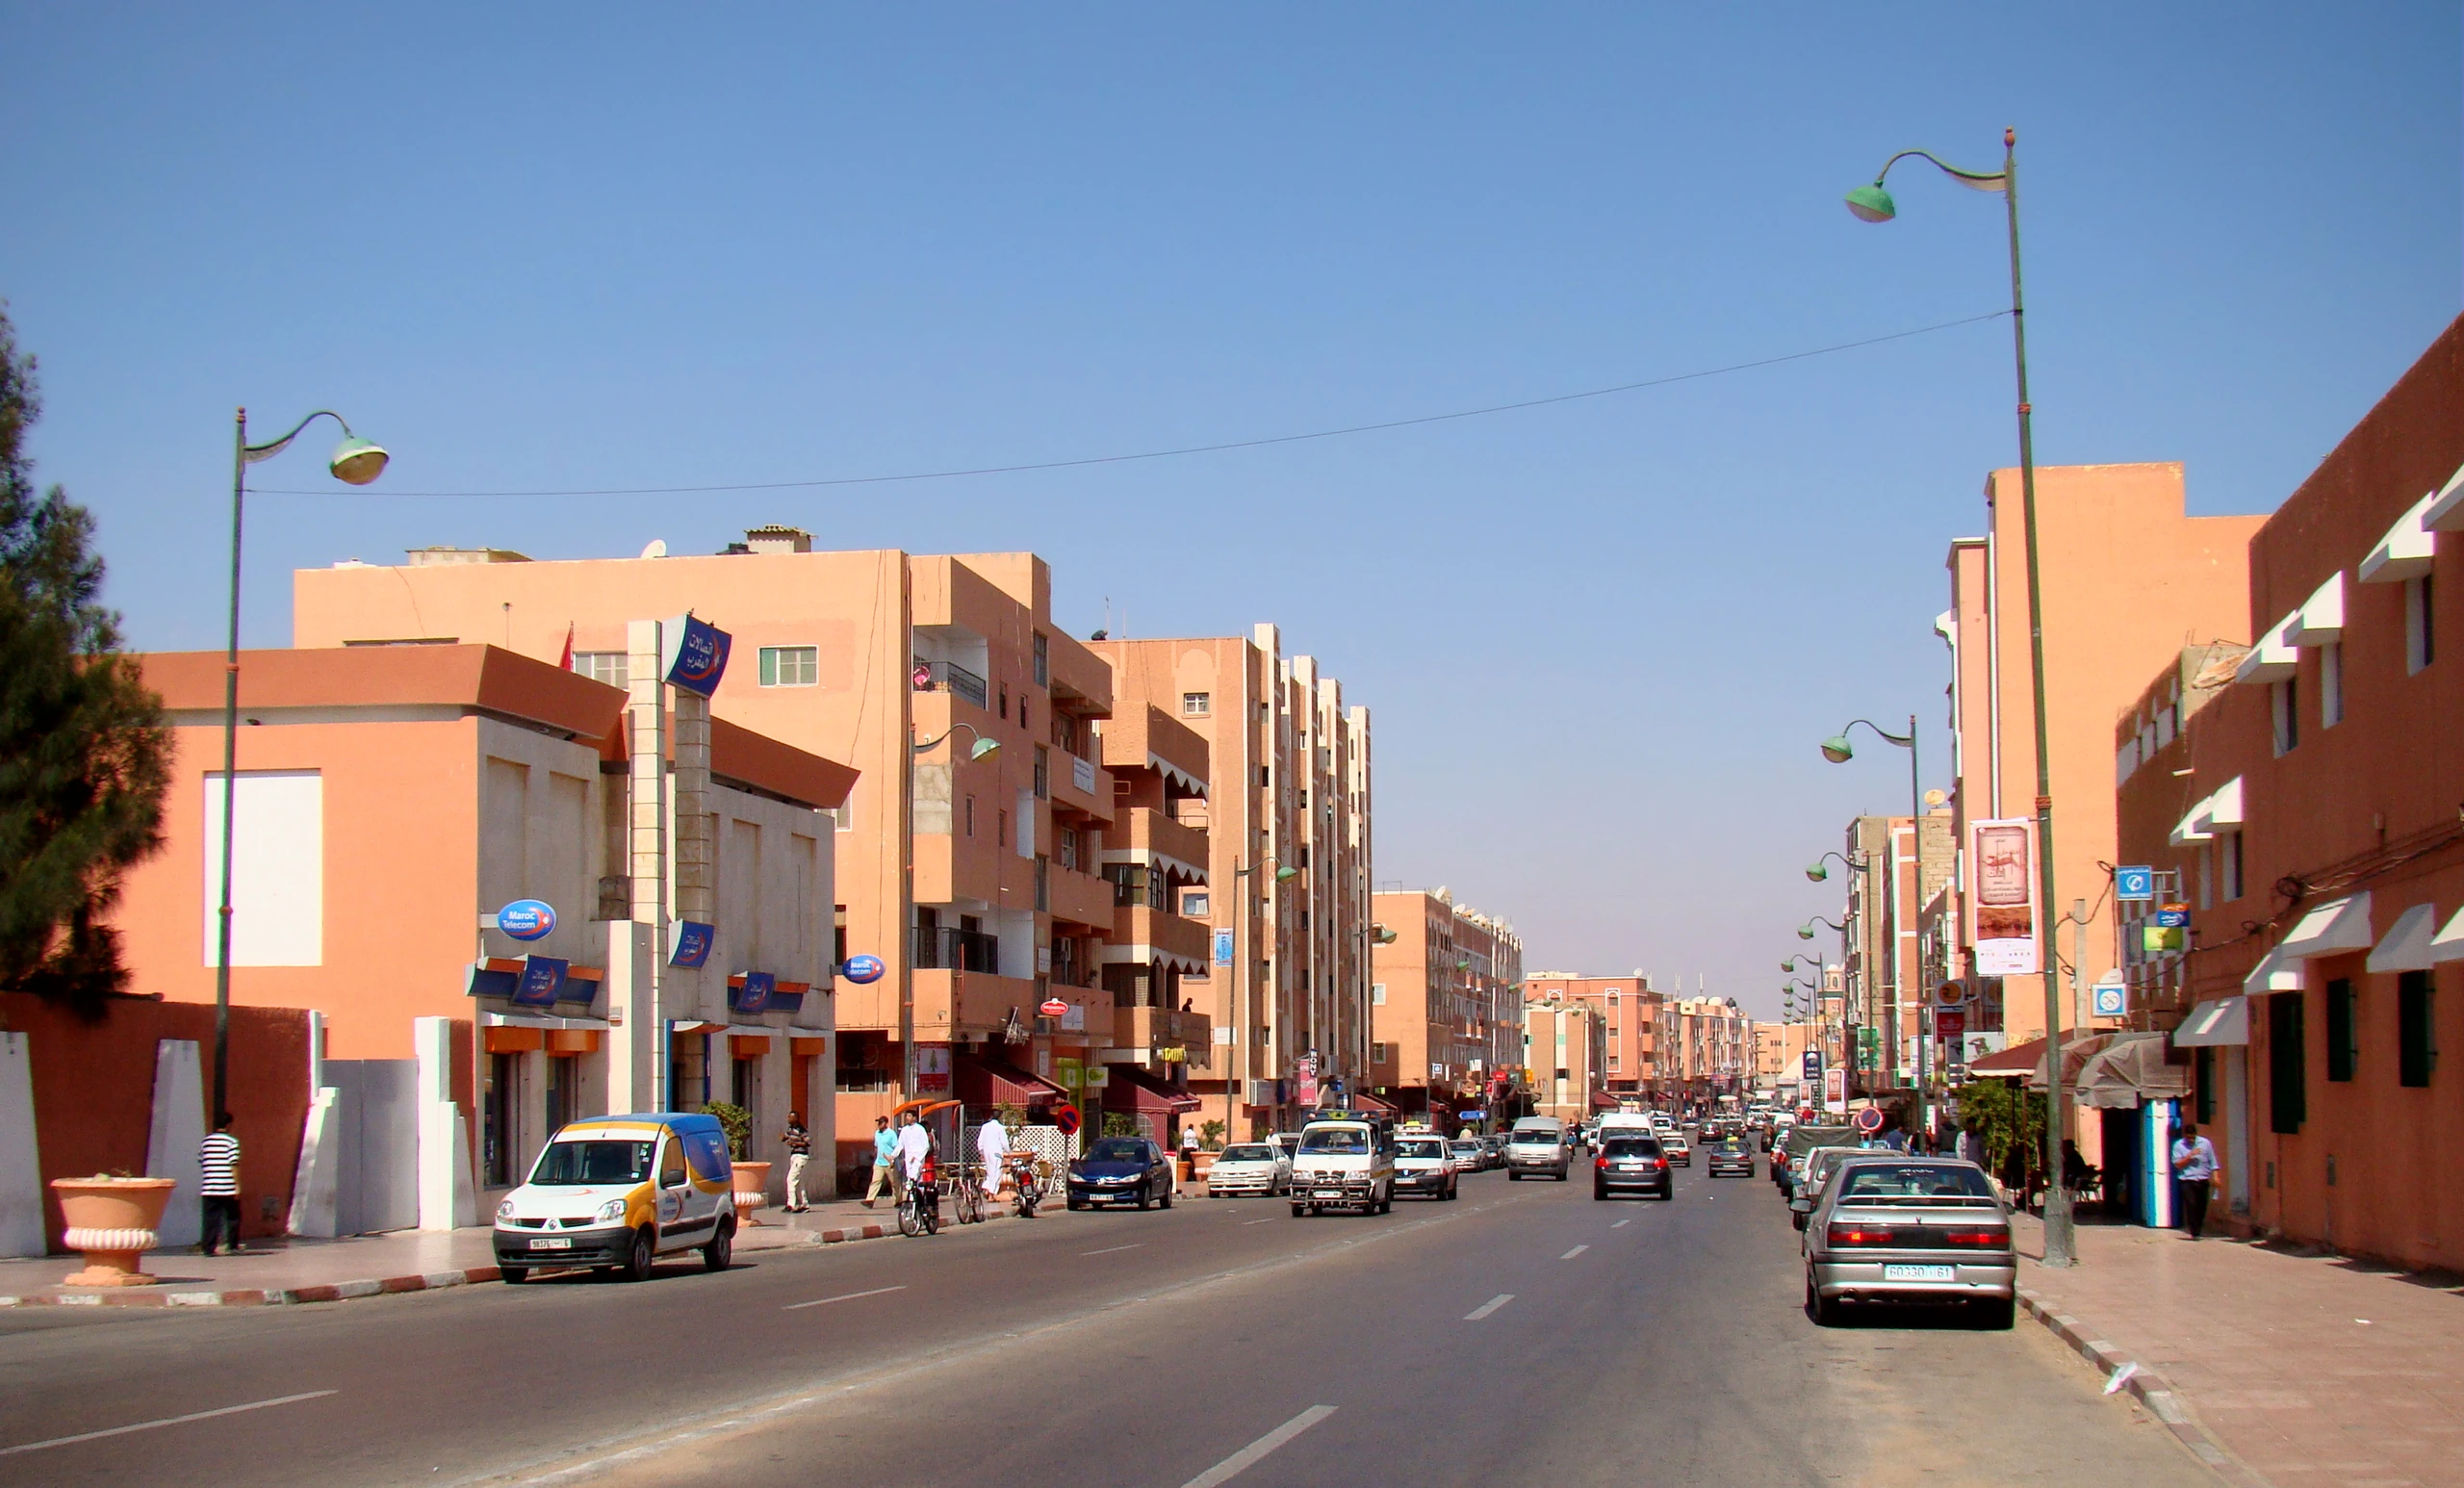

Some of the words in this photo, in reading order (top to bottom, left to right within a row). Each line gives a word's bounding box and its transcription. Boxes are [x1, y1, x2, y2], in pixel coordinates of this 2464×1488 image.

[688, 633, 714, 655] اتصالات
[686, 654, 710, 670] المغرب
[502, 920, 536, 929] Telecom
